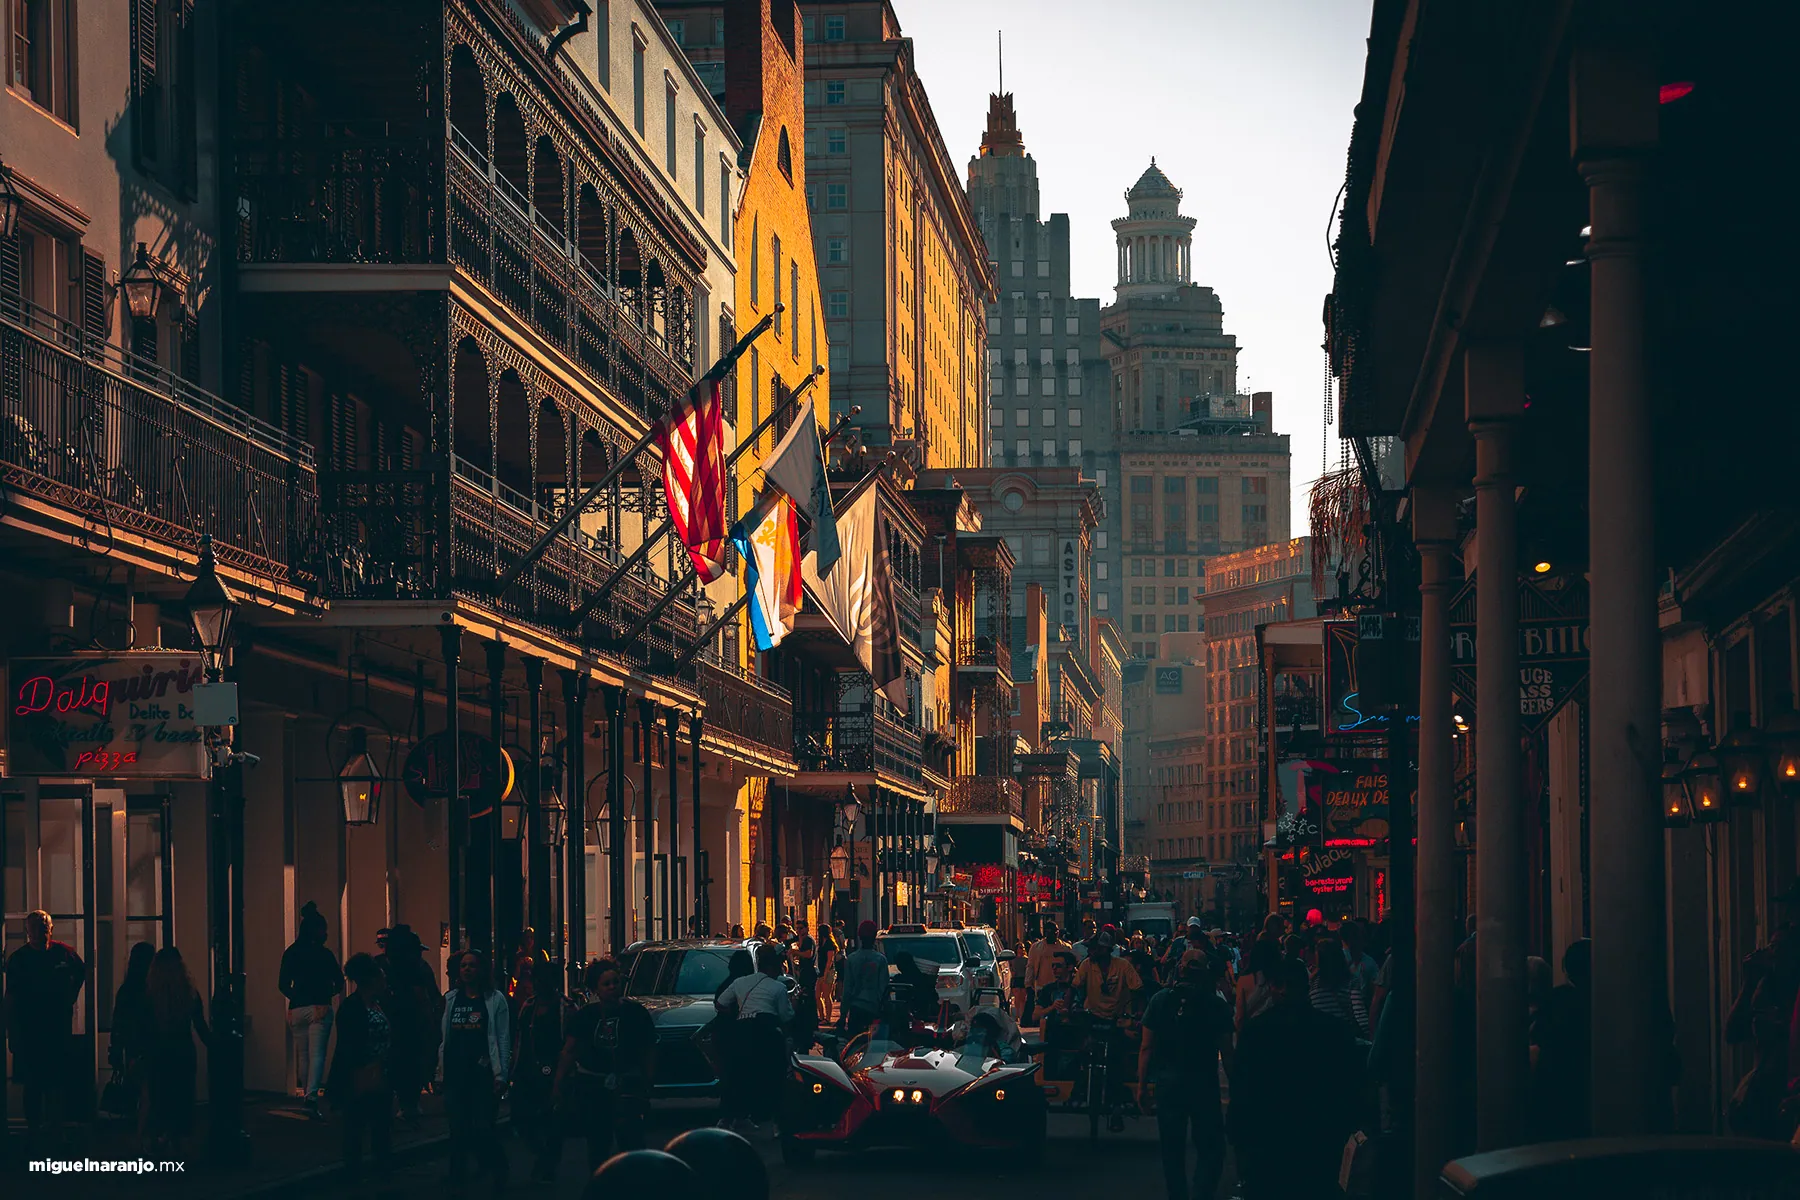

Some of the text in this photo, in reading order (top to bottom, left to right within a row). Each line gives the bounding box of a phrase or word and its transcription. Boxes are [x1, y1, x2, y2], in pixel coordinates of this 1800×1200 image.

[1063, 541, 1075, 623] ASTOR
[1520, 667, 1554, 684] UGE
[129, 703, 170, 720] Delite
[1520, 697, 1555, 715] EERS
[74, 745, 138, 771] pizza
[1355, 773, 1389, 789] FAIS
